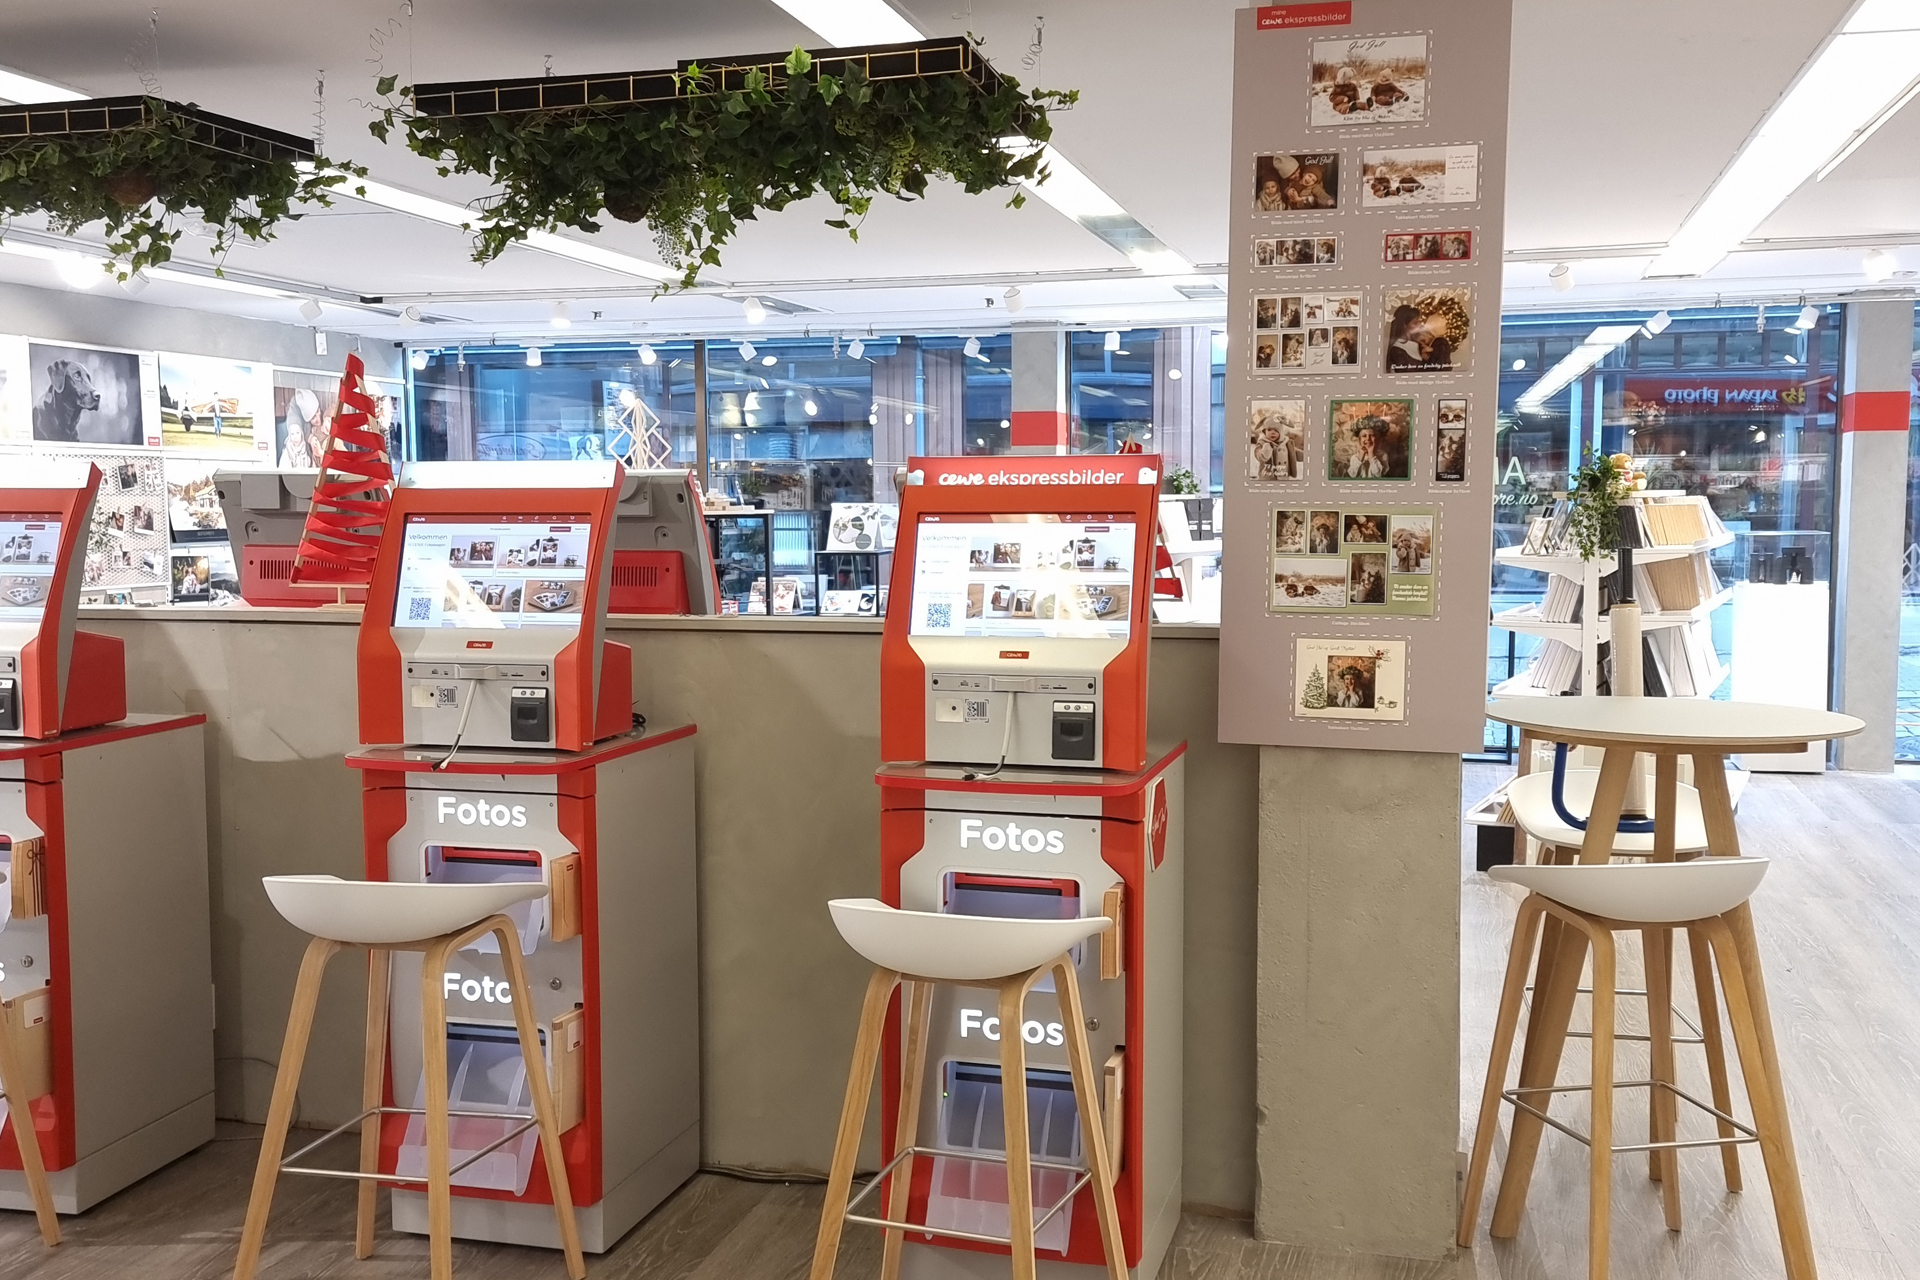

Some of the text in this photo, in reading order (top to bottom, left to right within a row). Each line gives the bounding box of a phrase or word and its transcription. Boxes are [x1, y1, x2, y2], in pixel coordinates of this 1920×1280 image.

[1284, 13, 1346, 24] ekspressbilder
[938, 469, 1125, 486] cewe ekspressbilder
[1494, 456, 1526, 486] A
[1494, 492, 1539, 506] ore.no
[438, 797, 528, 828] Fotos
[960, 819, 1064, 854] Fotos
[444, 972, 513, 1004] Foto
[960, 1008, 1064, 1046] Foos
